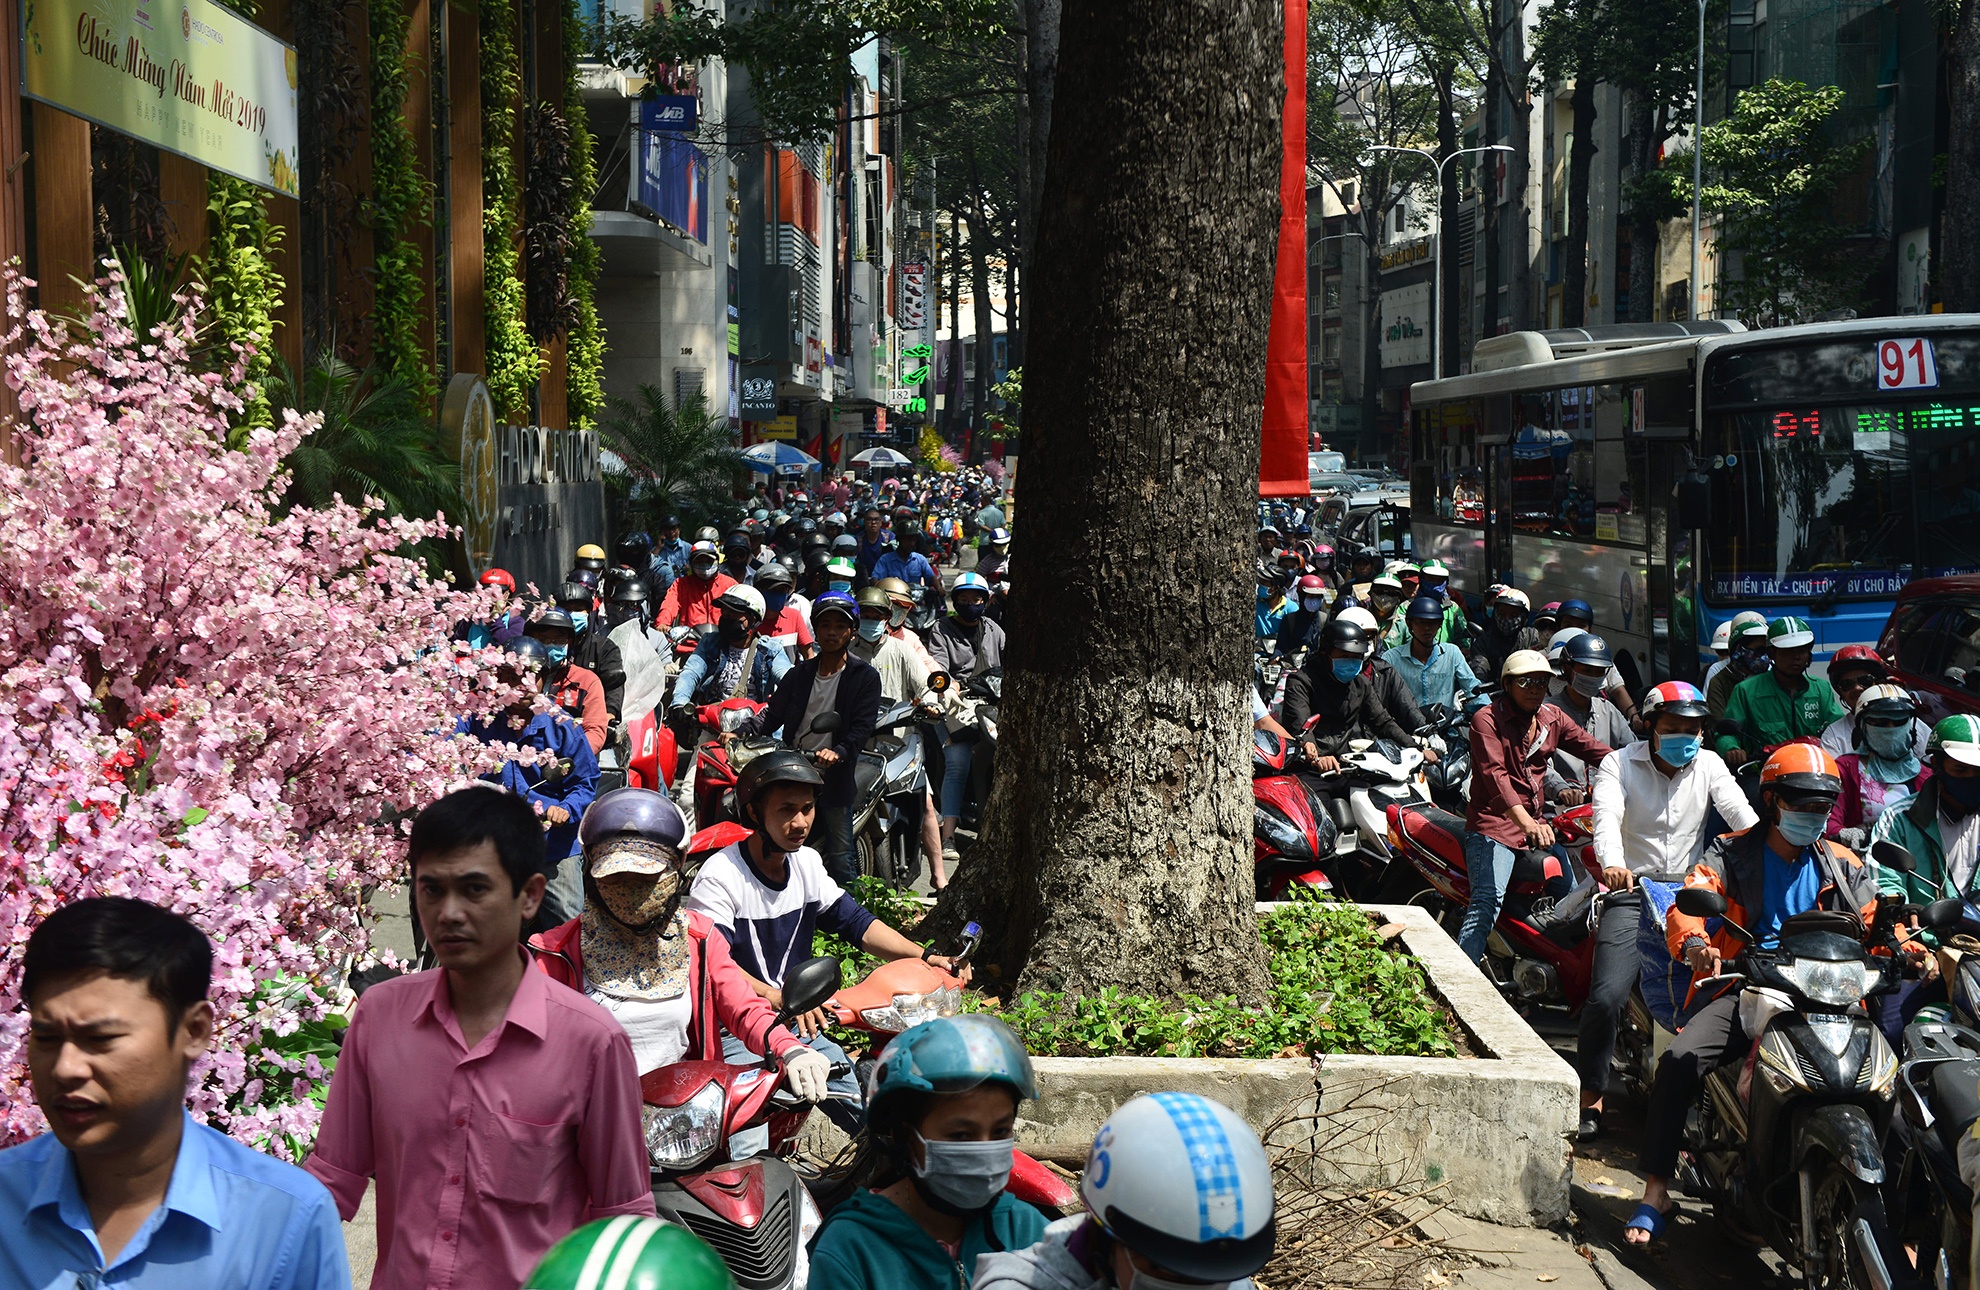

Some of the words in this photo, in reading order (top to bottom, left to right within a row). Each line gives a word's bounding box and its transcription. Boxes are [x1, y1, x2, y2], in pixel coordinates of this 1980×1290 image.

[77, 12, 118, 68] Chúc
[121, 36, 166, 98] Mừng
[170, 58, 207, 109] Năm
[208, 78, 235, 122] Mới
[237, 96, 266, 137] 2019
[1880, 338, 1927, 388] 91
[891, 390, 909, 400] 182
[1634, 390, 1643, 431] 91
[504, 503, 562, 536] GARDEN
[1717, 582, 1729, 594] BX
[1732, 575, 1758, 594] MIỀN
[1761, 579, 1781, 594] TÂY
[1792, 580, 1812, 596] CHỢ
[1848, 581, 1860, 593] BV
[1864, 579, 1884, 594] CHỢ
